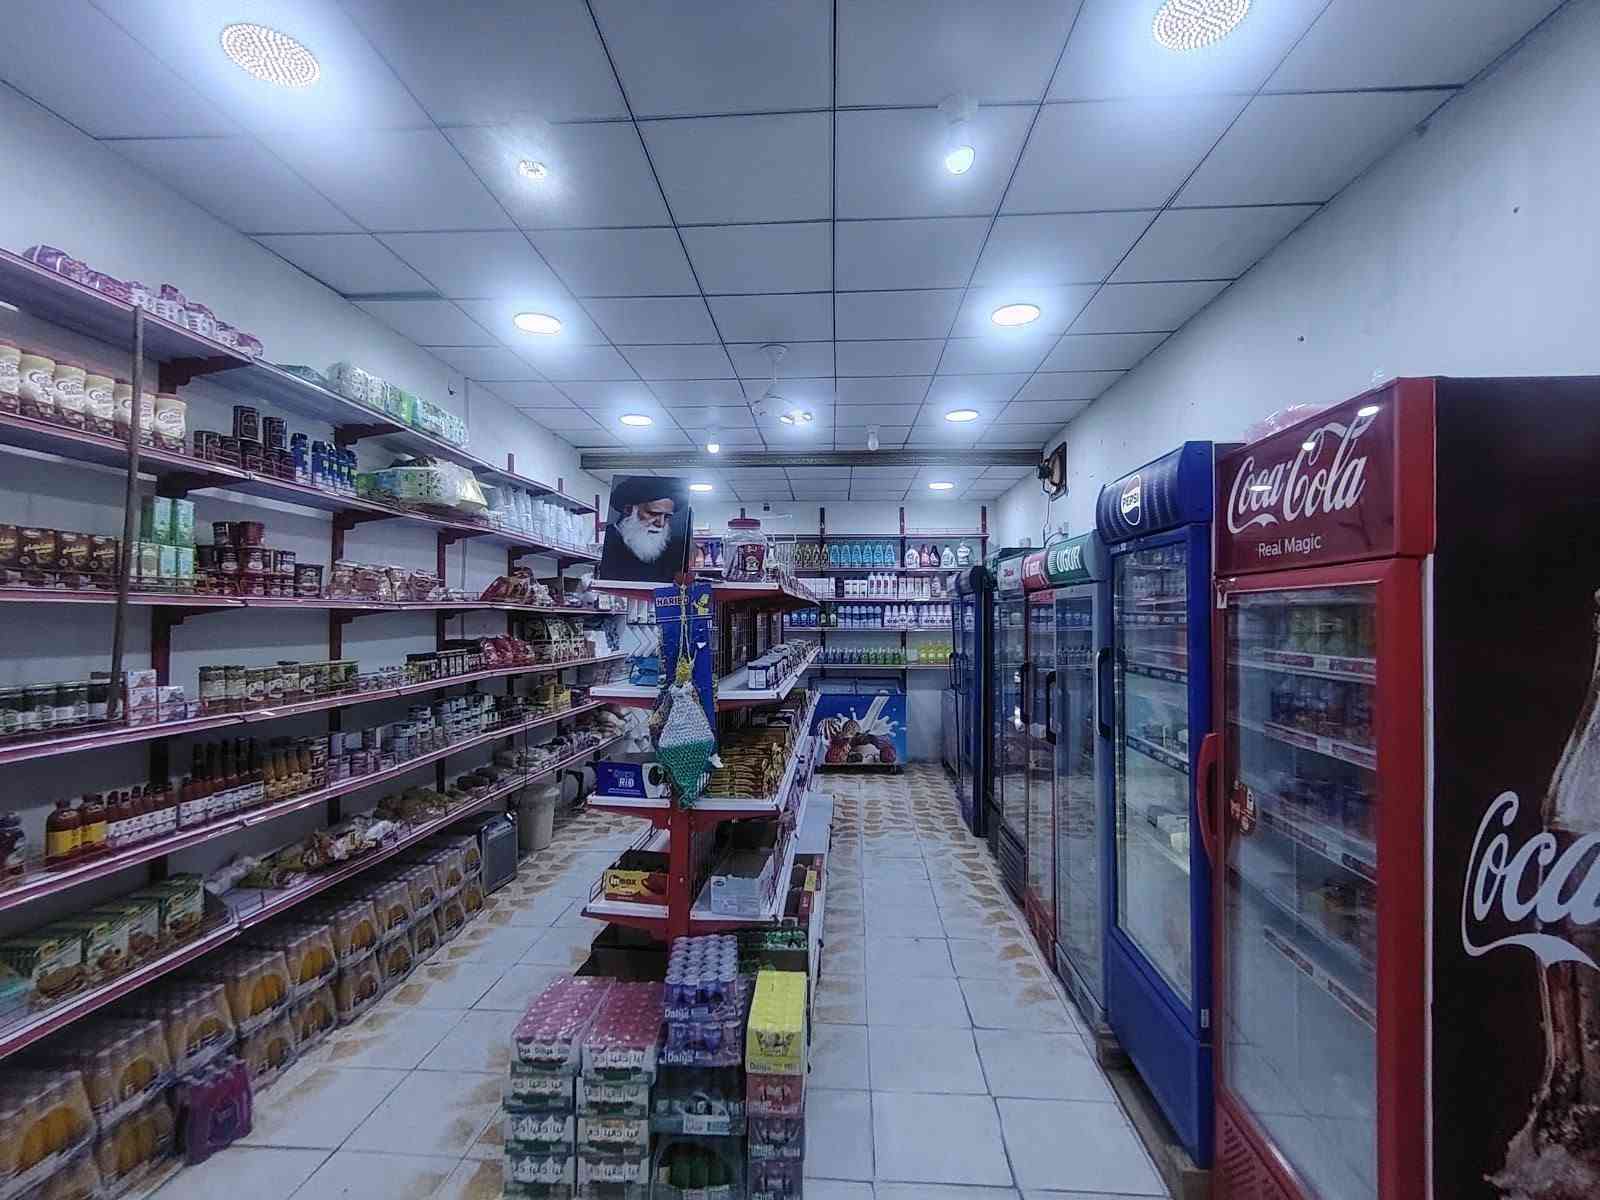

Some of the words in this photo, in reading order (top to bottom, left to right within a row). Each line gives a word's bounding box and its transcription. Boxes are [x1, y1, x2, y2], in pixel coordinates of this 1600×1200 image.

[1227, 413, 1377, 534] Coca-Cola
[1259, 542, 1282, 558] Real
[1285, 533, 1321, 554] Magic
